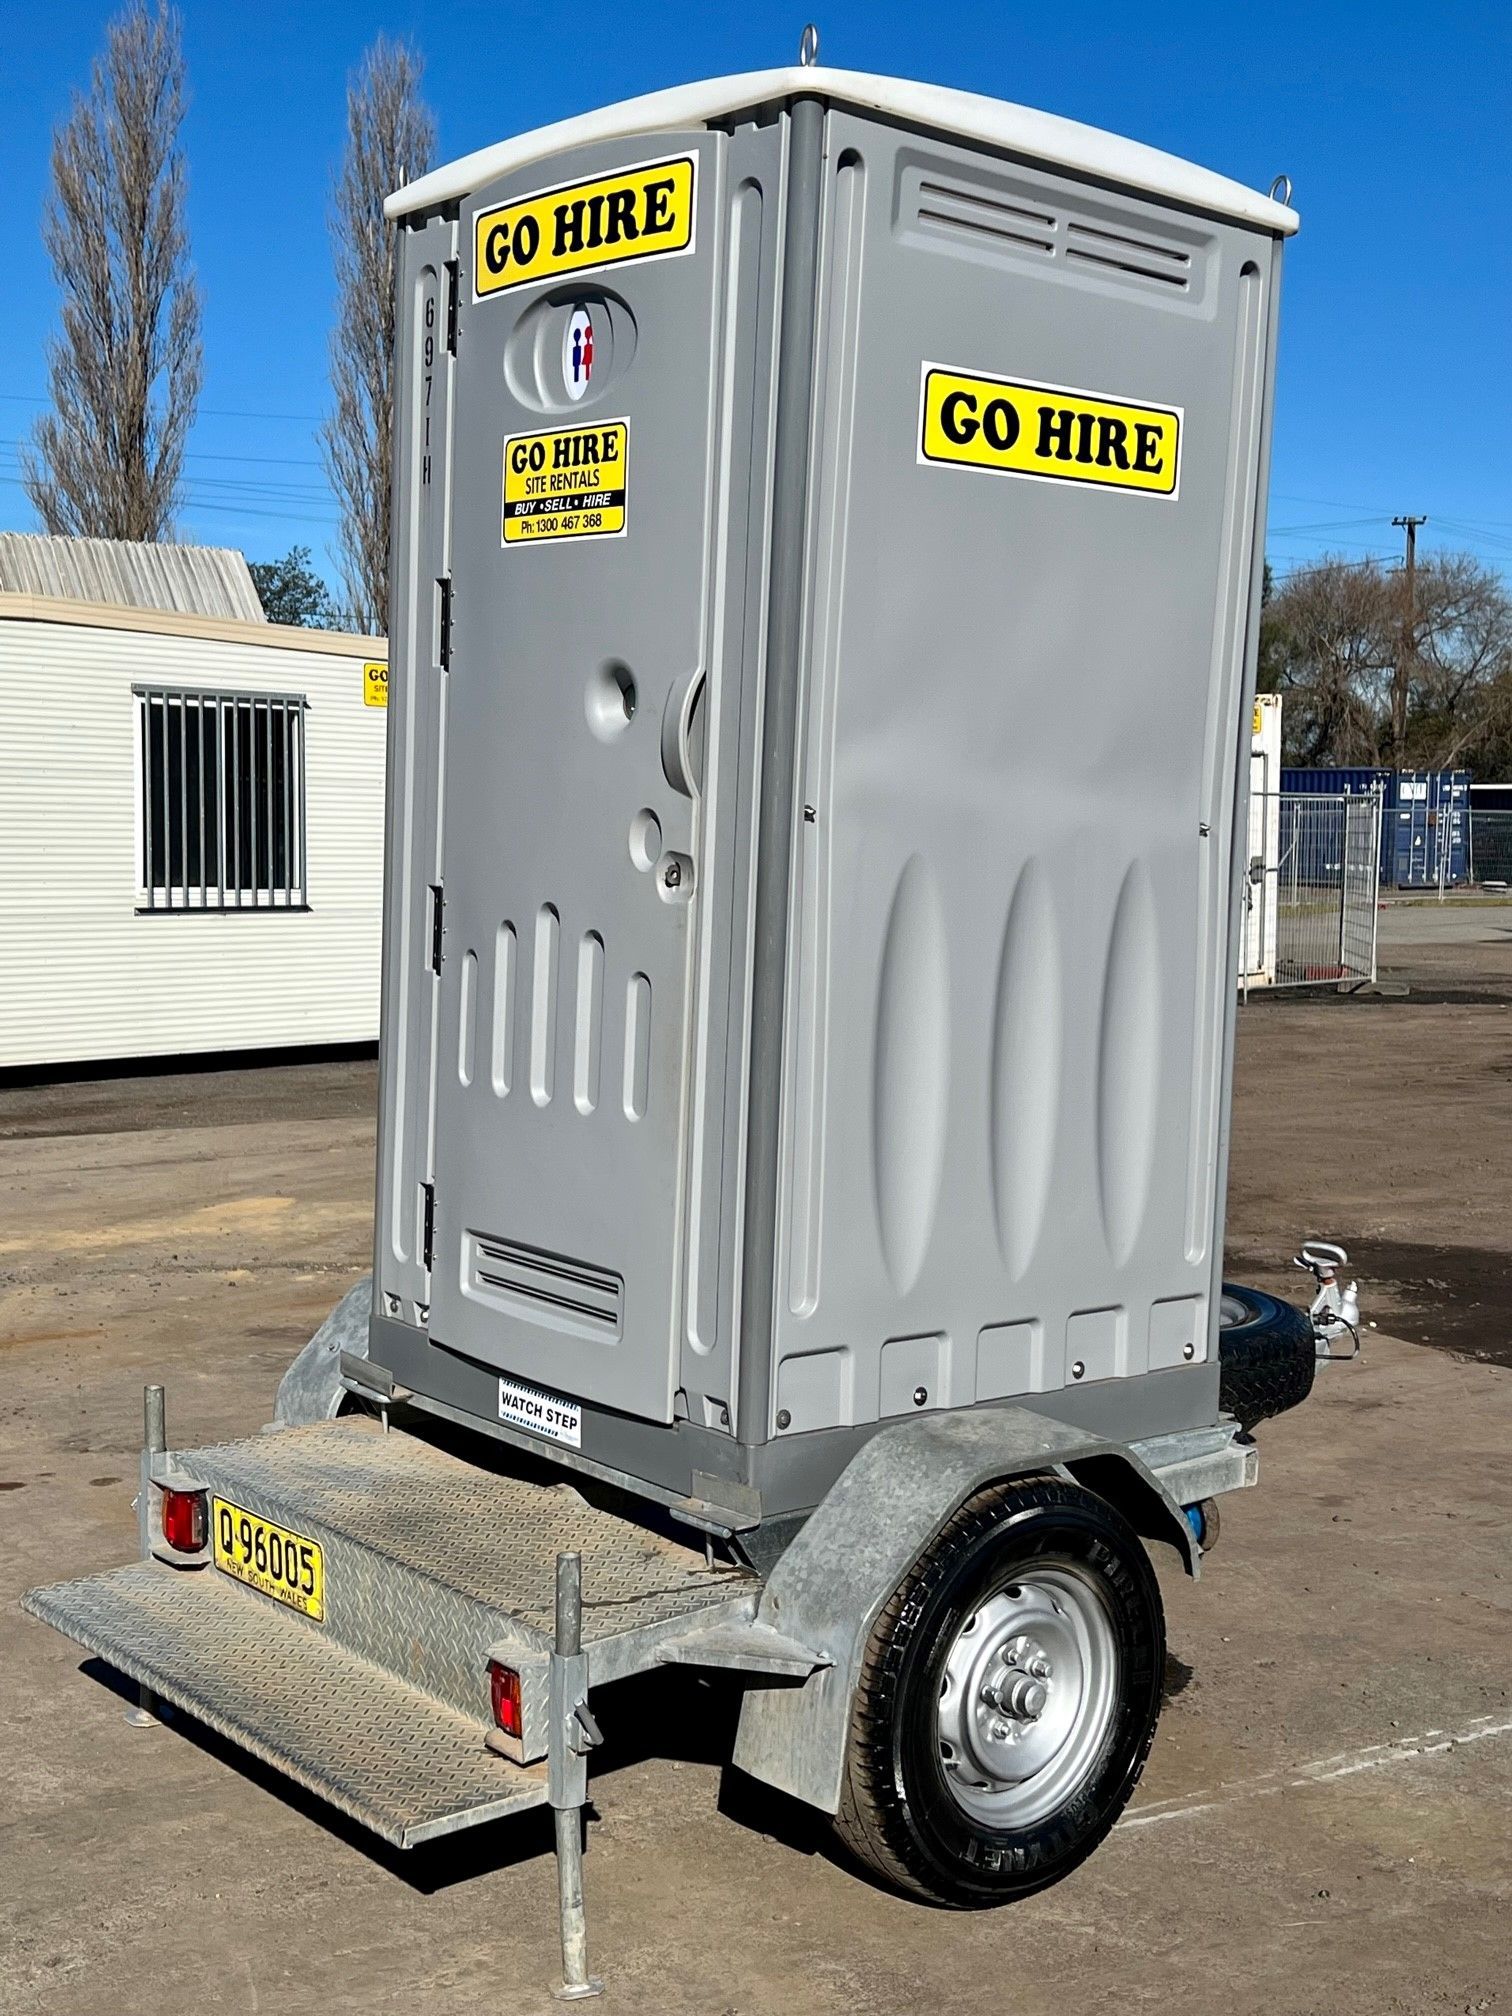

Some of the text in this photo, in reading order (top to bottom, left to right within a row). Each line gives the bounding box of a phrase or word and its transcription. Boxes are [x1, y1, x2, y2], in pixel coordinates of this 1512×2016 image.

[485, 178, 675, 274] GO HIRE
[512, 430, 618, 474] GO HIRE
[941, 391, 1163, 474] GO HIRE
[525, 469, 600, 495] SITE RENTALS
[515, 493, 612, 515] BUY SELL HIRE
[561, 515, 581, 530] 467
[583, 513, 602, 528] 368
[502, 1391, 577, 1430] WATCH STEP
[227, 1558, 308, 1611] NEW SOUTH WALES
